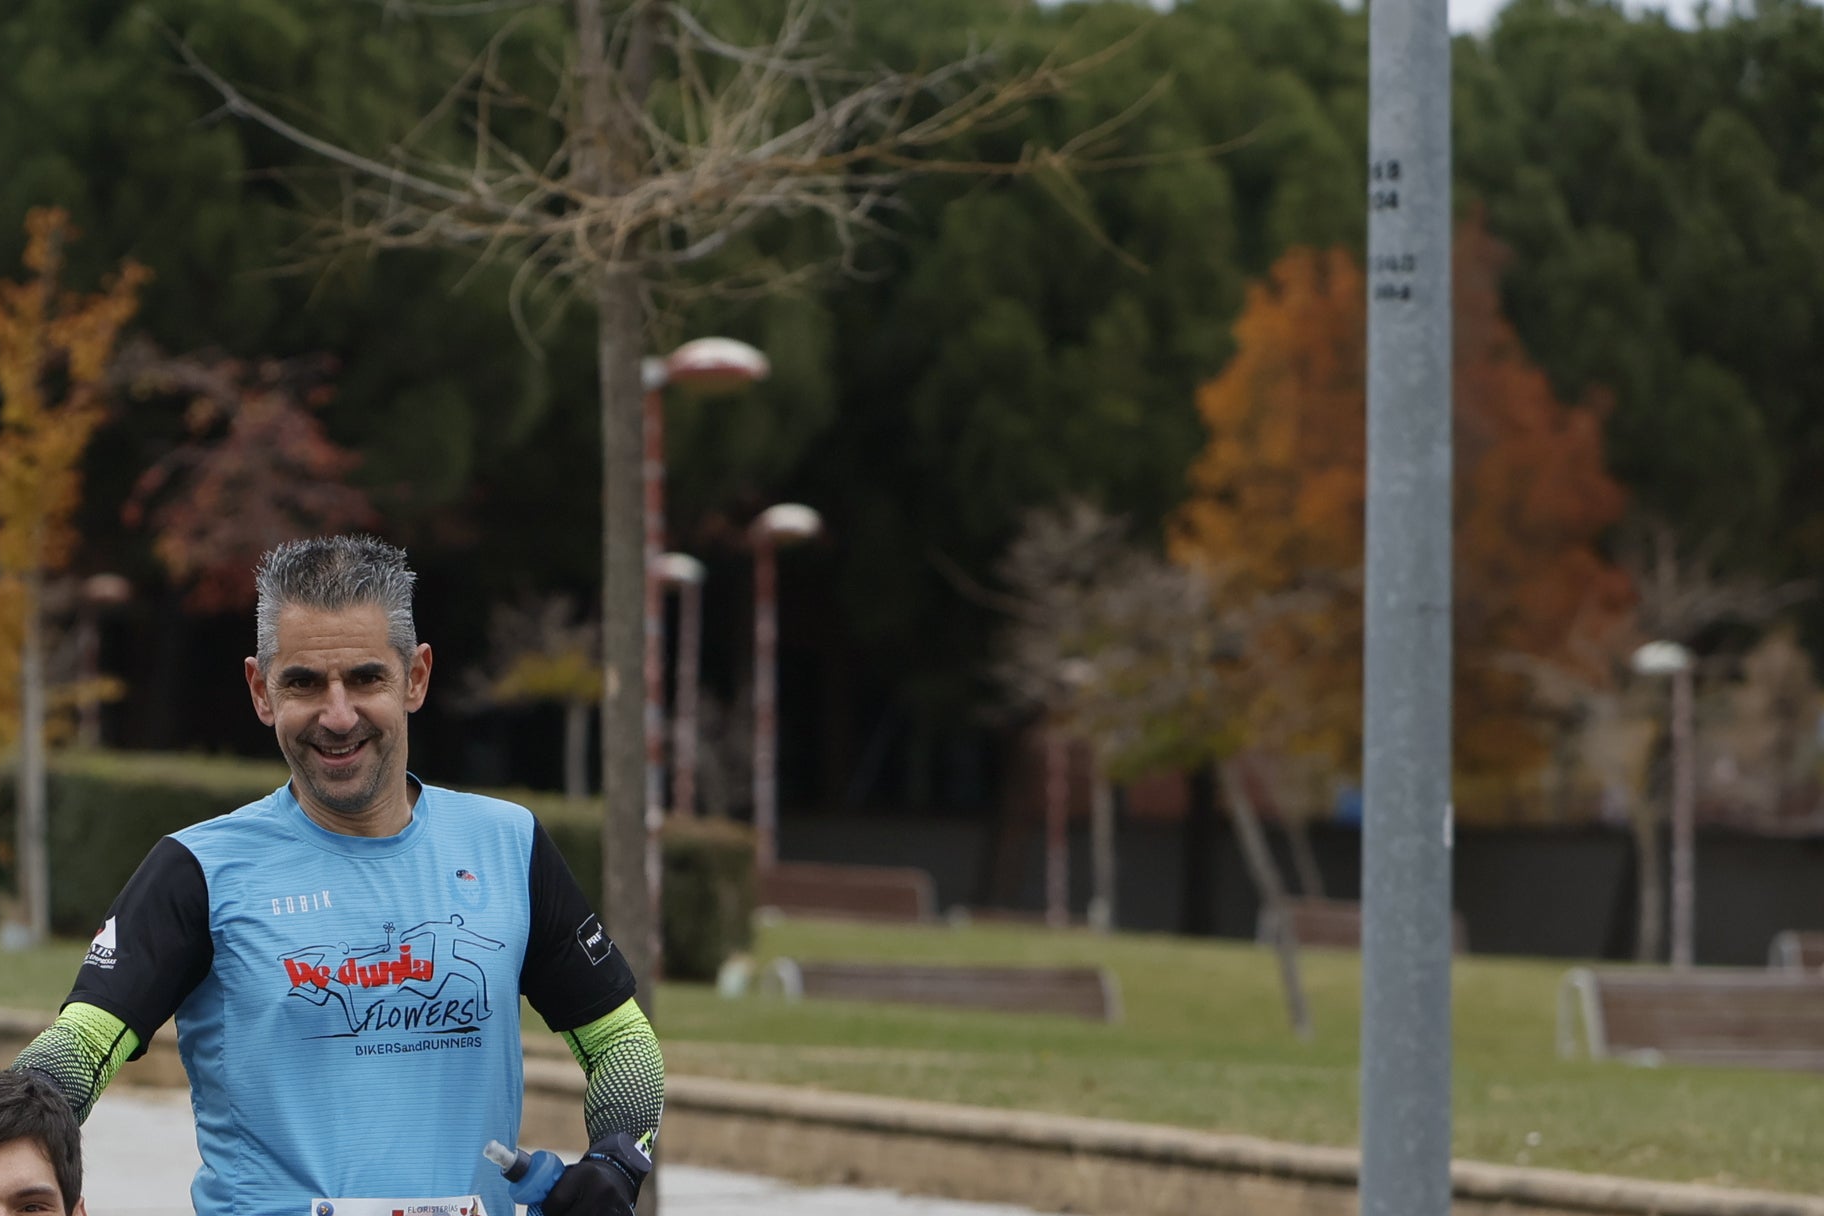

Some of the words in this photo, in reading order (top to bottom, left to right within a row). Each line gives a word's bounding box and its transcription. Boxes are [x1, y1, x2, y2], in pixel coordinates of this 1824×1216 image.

[271, 890, 332, 916] GOBIK
[283, 945, 435, 988] bedunia
[363, 999, 475, 1032] FLOWERS
[354, 1036, 483, 1056] BIKERSandRUNNERS
[407, 1203, 459, 1214] FLORISTERÍAS
